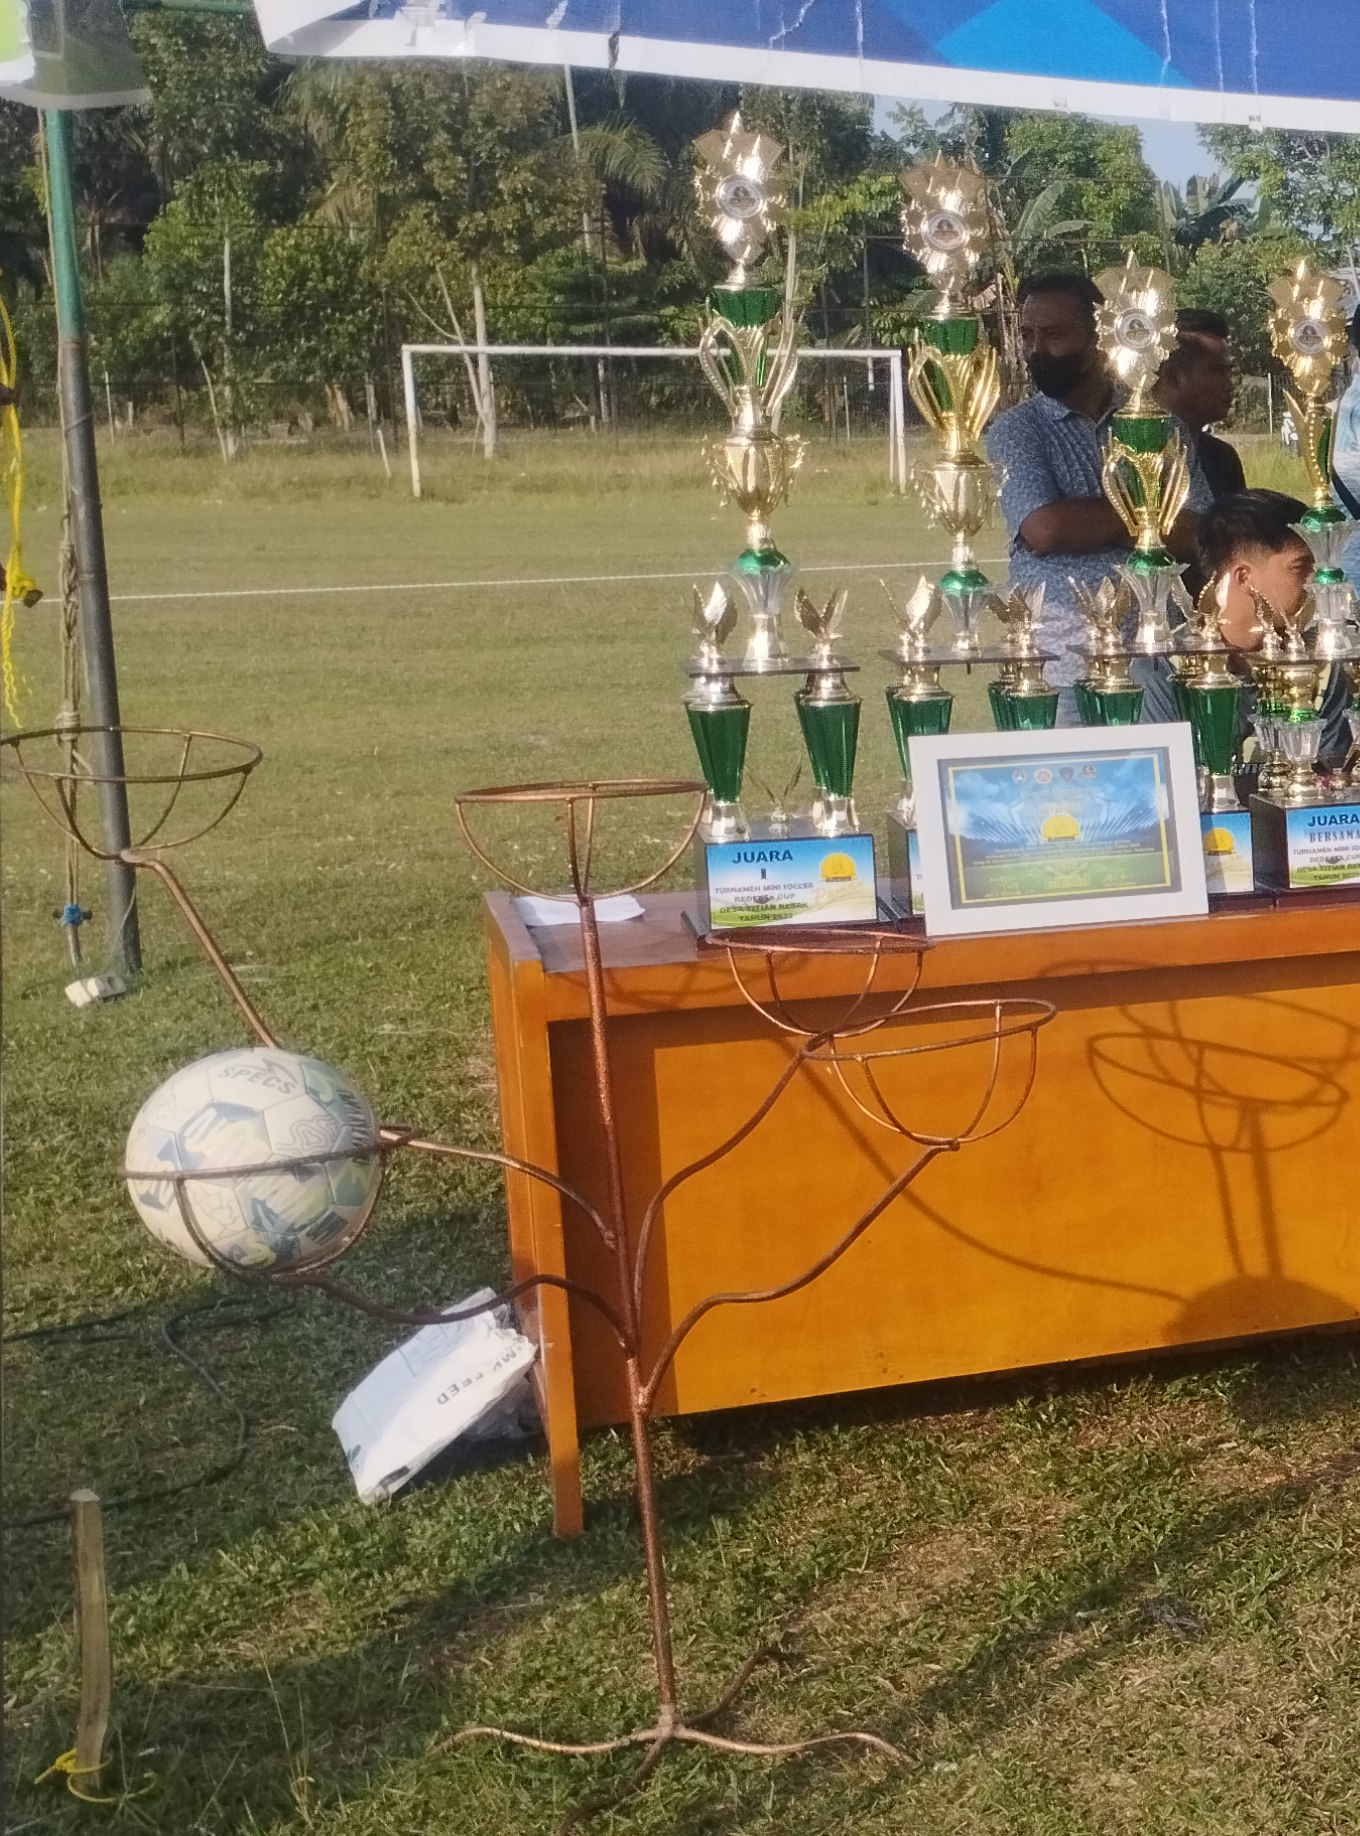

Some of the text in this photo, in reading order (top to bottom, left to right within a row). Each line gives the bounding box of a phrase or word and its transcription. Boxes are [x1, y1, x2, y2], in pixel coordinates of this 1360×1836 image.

[1308, 813, 1360, 826] JUARA
[1309, 829, 1360, 843] BERSAMA
[732, 850, 793, 864] JUARA
[217, 1066, 297, 1095] SPECS
